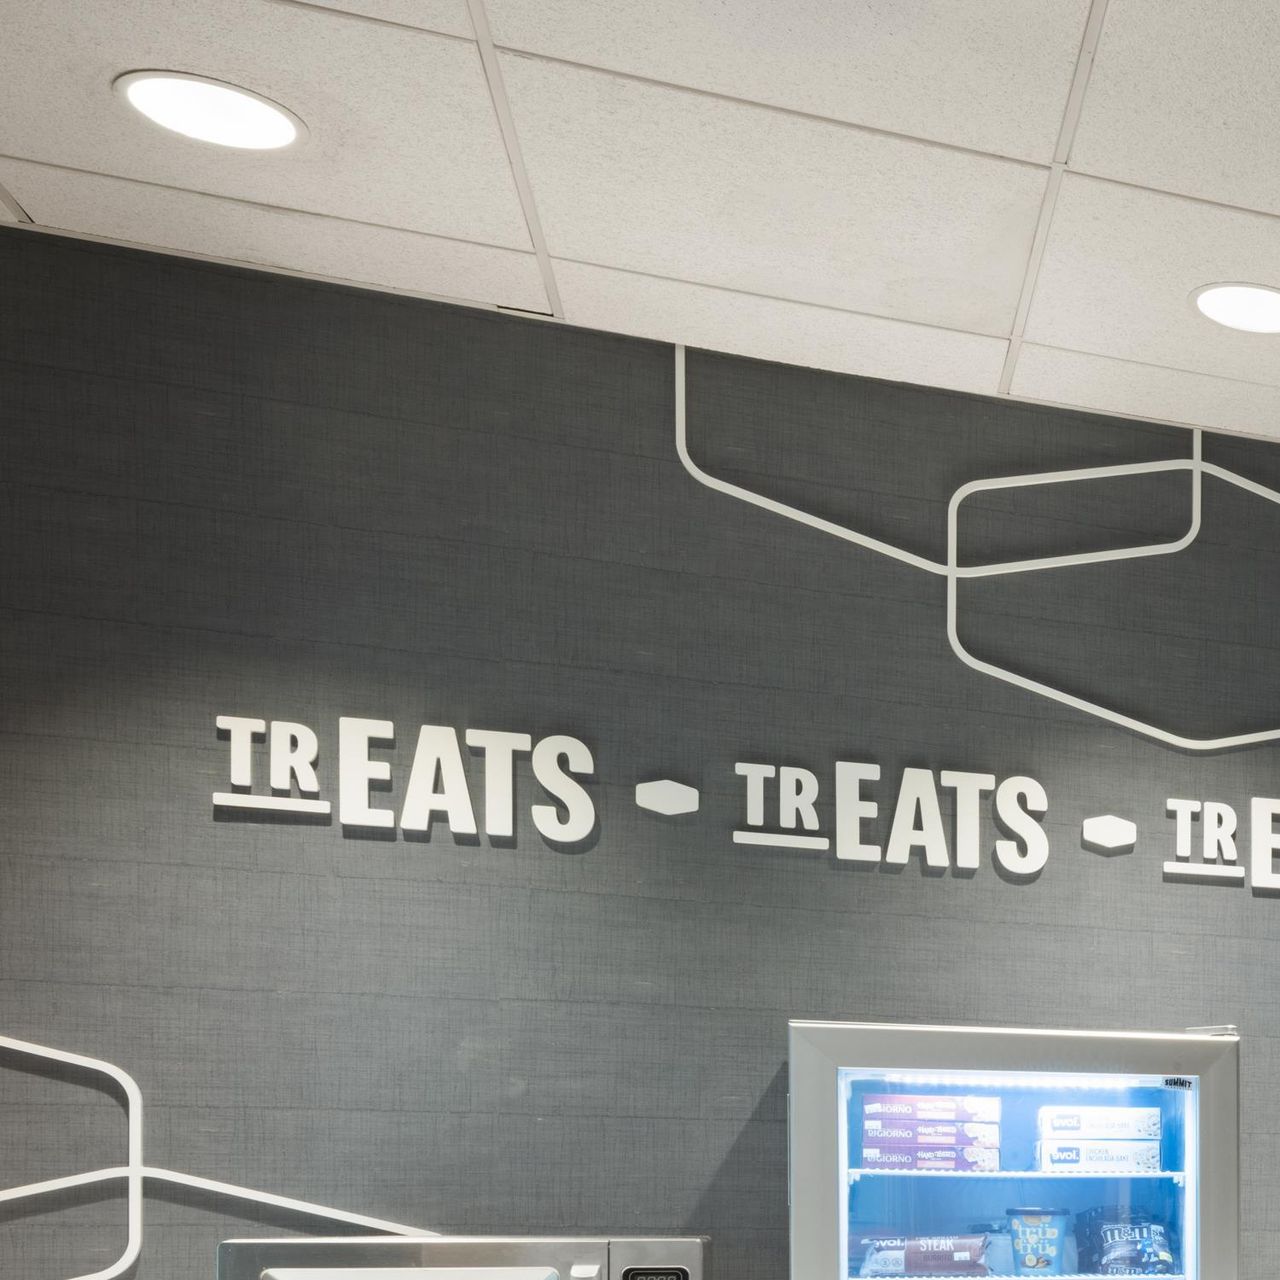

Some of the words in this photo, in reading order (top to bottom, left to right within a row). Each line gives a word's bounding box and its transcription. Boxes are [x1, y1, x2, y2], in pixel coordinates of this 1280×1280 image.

[214, 714, 597, 845] TREATS
[733, 760, 1049, 875] TREATS
[1164, 1077, 1193, 1089] SUMMIT
[1051, 1150, 1080, 1161] evol.
[919, 1238, 955, 1252] STEAK
